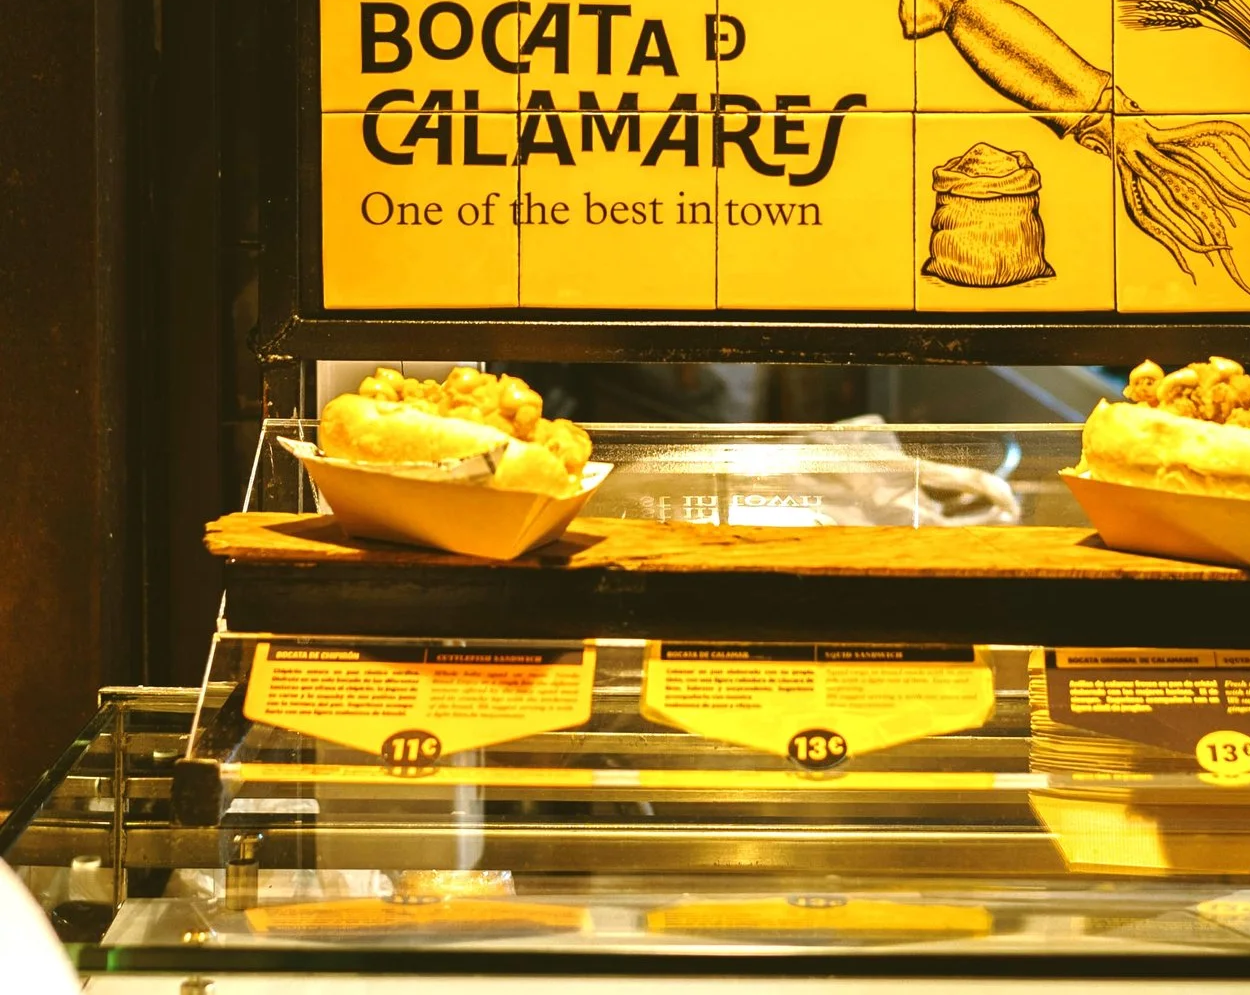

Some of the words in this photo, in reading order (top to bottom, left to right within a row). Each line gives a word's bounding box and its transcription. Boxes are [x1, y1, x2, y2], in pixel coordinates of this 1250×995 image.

[360, 1, 679, 77] BOCATA
[363, 89, 867, 186] CALAMARES
[361, 191, 443, 225] One
[457, 192, 500, 225] of
[509, 191, 569, 225] the
[584, 191, 663, 225] best
[676, 191, 713, 225] in
[724, 198, 822, 225] town
[392, 737, 438, 762] 11€
[794, 735, 844, 761] 13€
